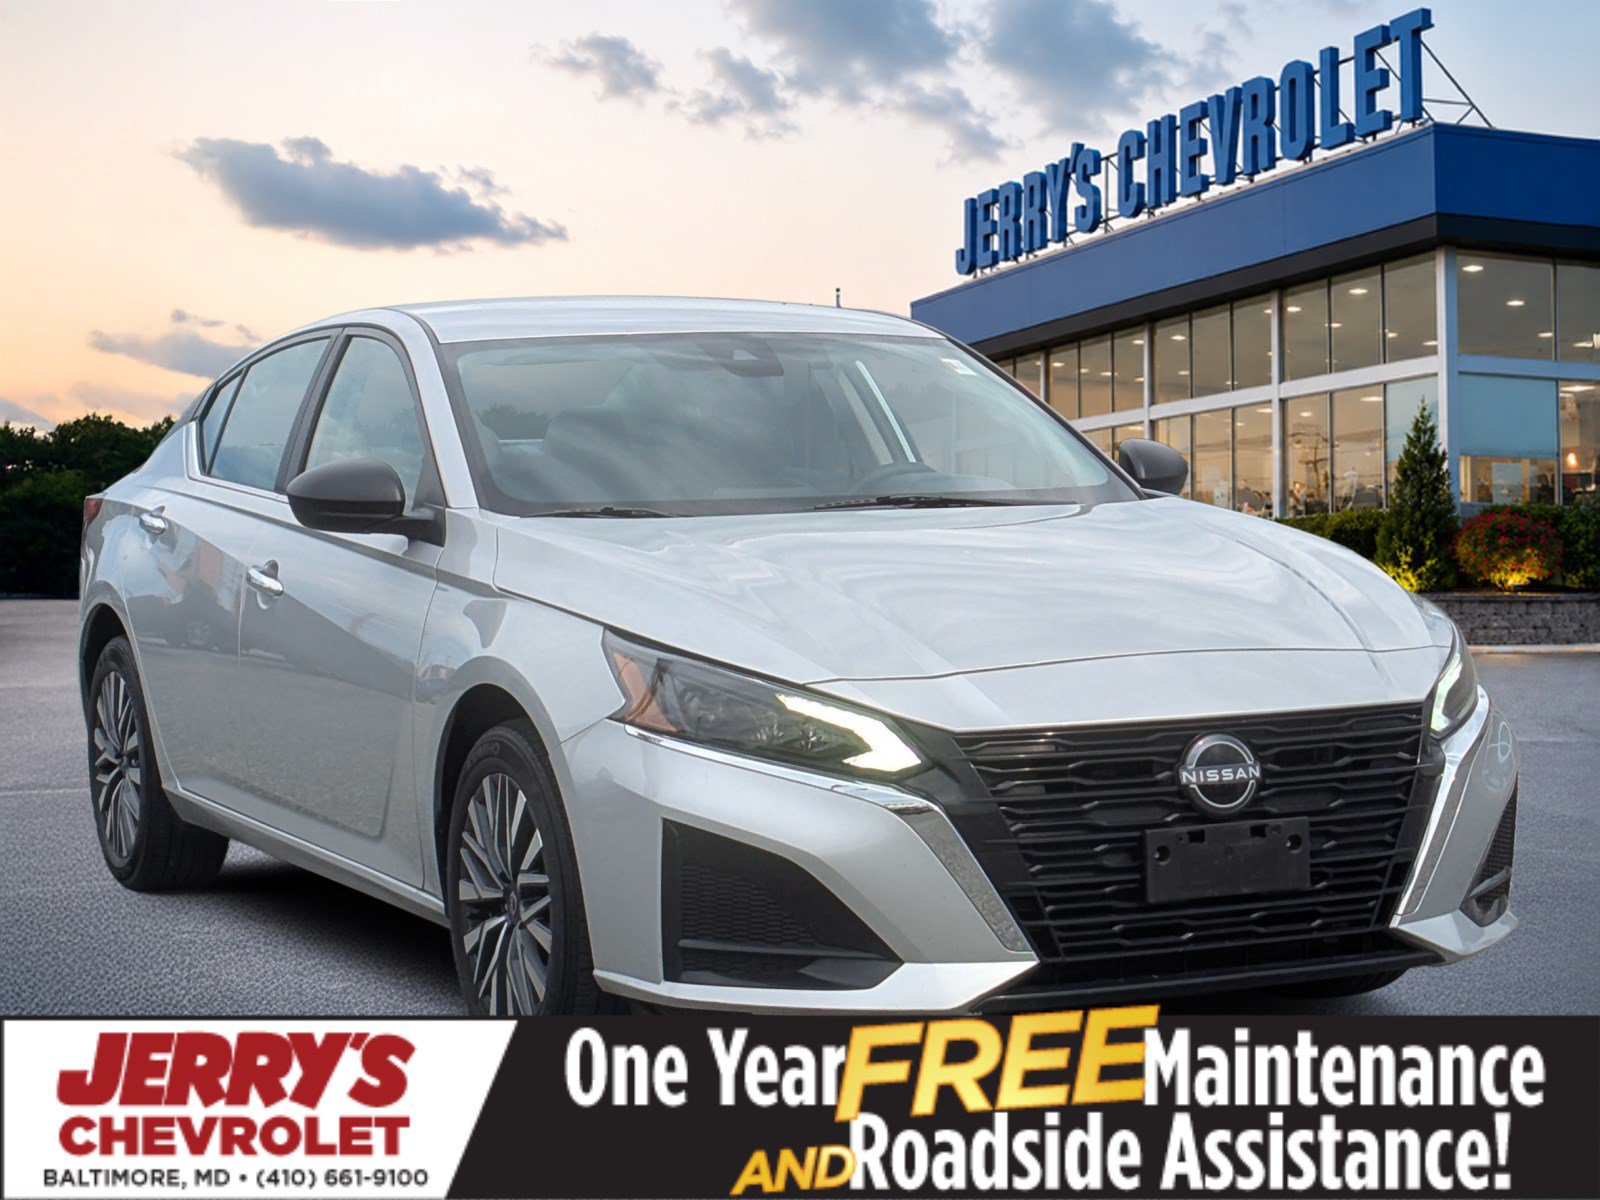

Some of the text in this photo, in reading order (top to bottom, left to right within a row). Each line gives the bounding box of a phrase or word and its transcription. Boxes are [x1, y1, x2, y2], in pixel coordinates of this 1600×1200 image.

[955, 7, 1434, 276] JERRY'S CHEVROLET
[1181, 765, 1260, 783] NISSAN
